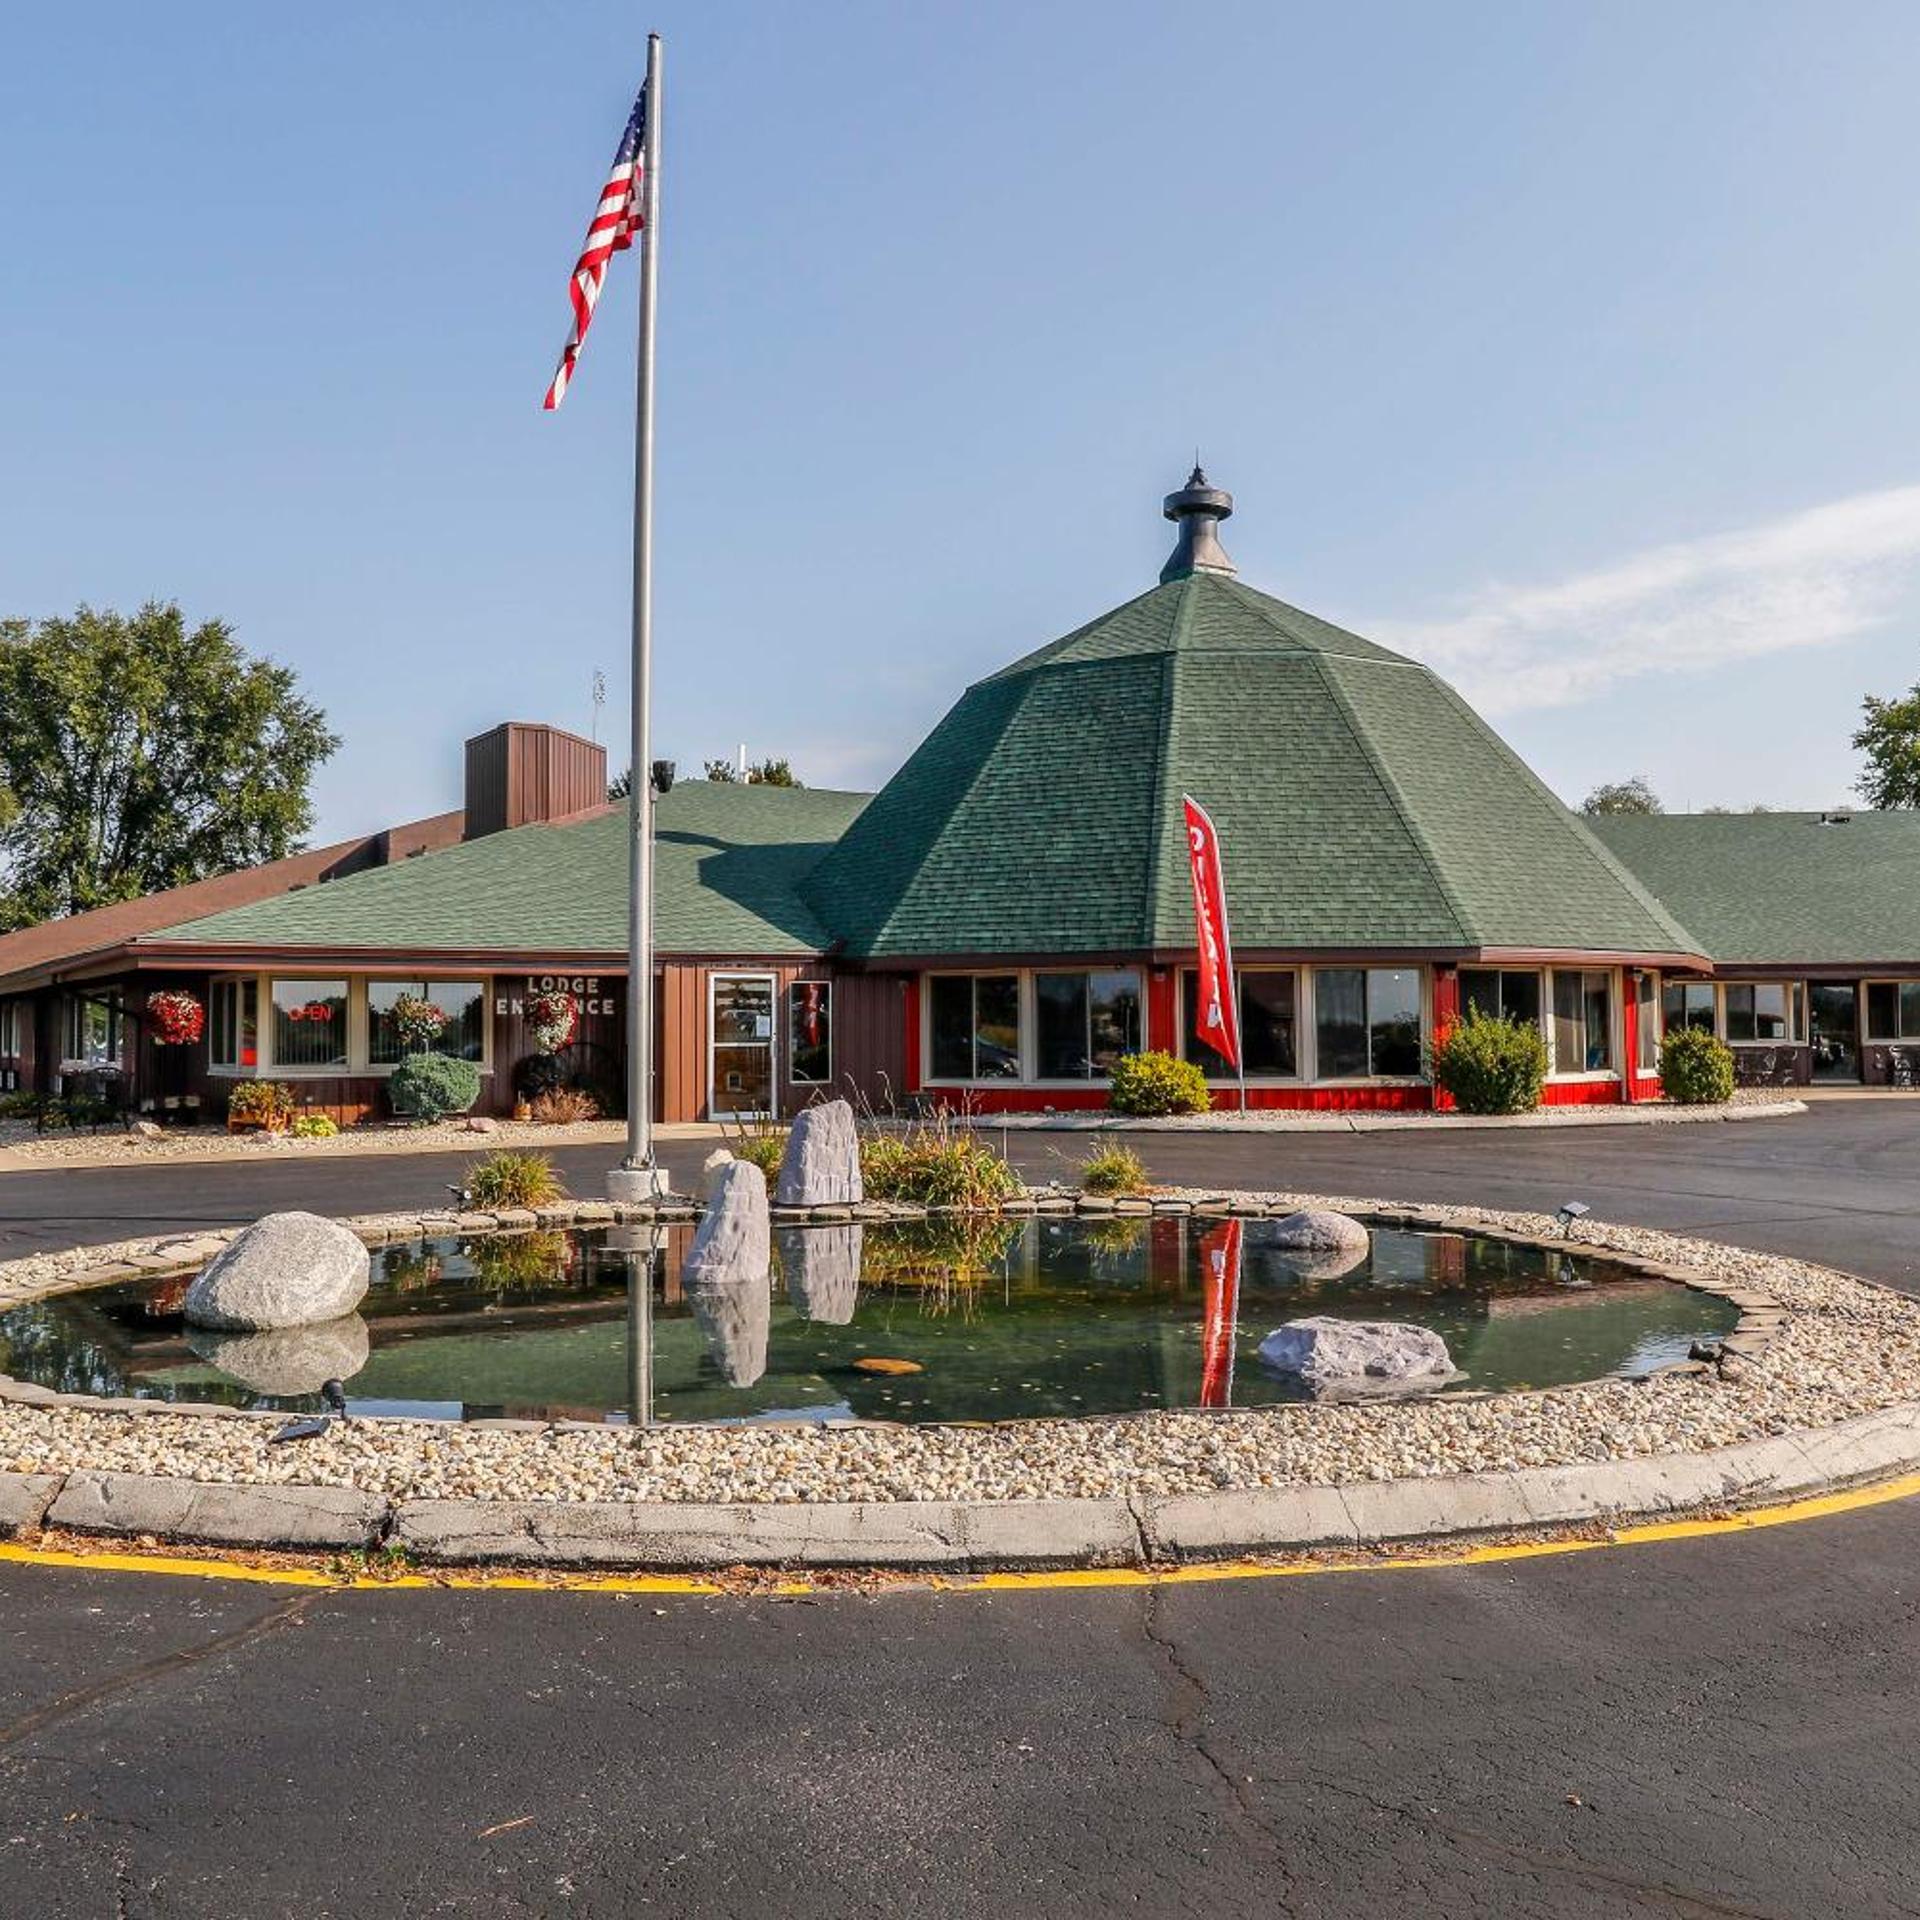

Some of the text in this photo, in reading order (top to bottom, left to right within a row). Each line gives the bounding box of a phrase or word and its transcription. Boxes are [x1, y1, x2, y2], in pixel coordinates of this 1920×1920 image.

[527, 976, 599, 993] LODGE
[288, 1004, 332, 1021] OPEN
[496, 998, 615, 1015] ENNCE
